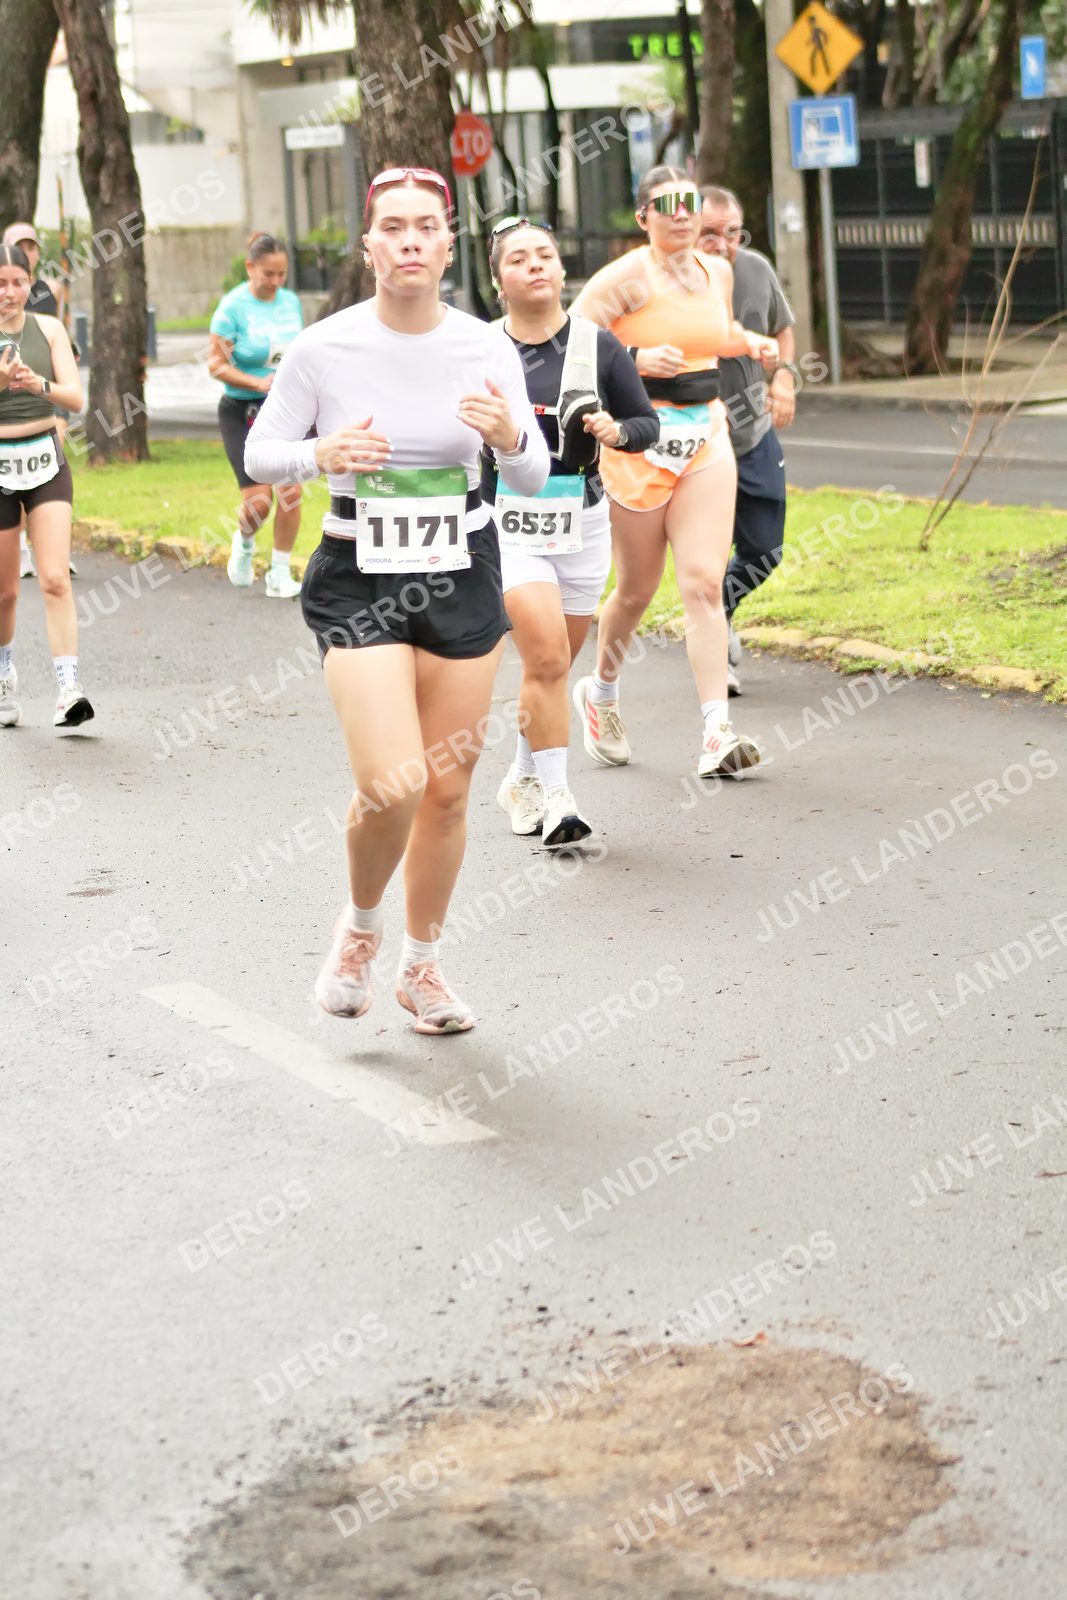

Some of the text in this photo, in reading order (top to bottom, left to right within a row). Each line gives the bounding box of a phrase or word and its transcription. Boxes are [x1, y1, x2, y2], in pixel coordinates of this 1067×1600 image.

[0, 453, 52, 476] 5109
[367, 515, 458, 547] 1171
[501, 510, 572, 536] 6531
